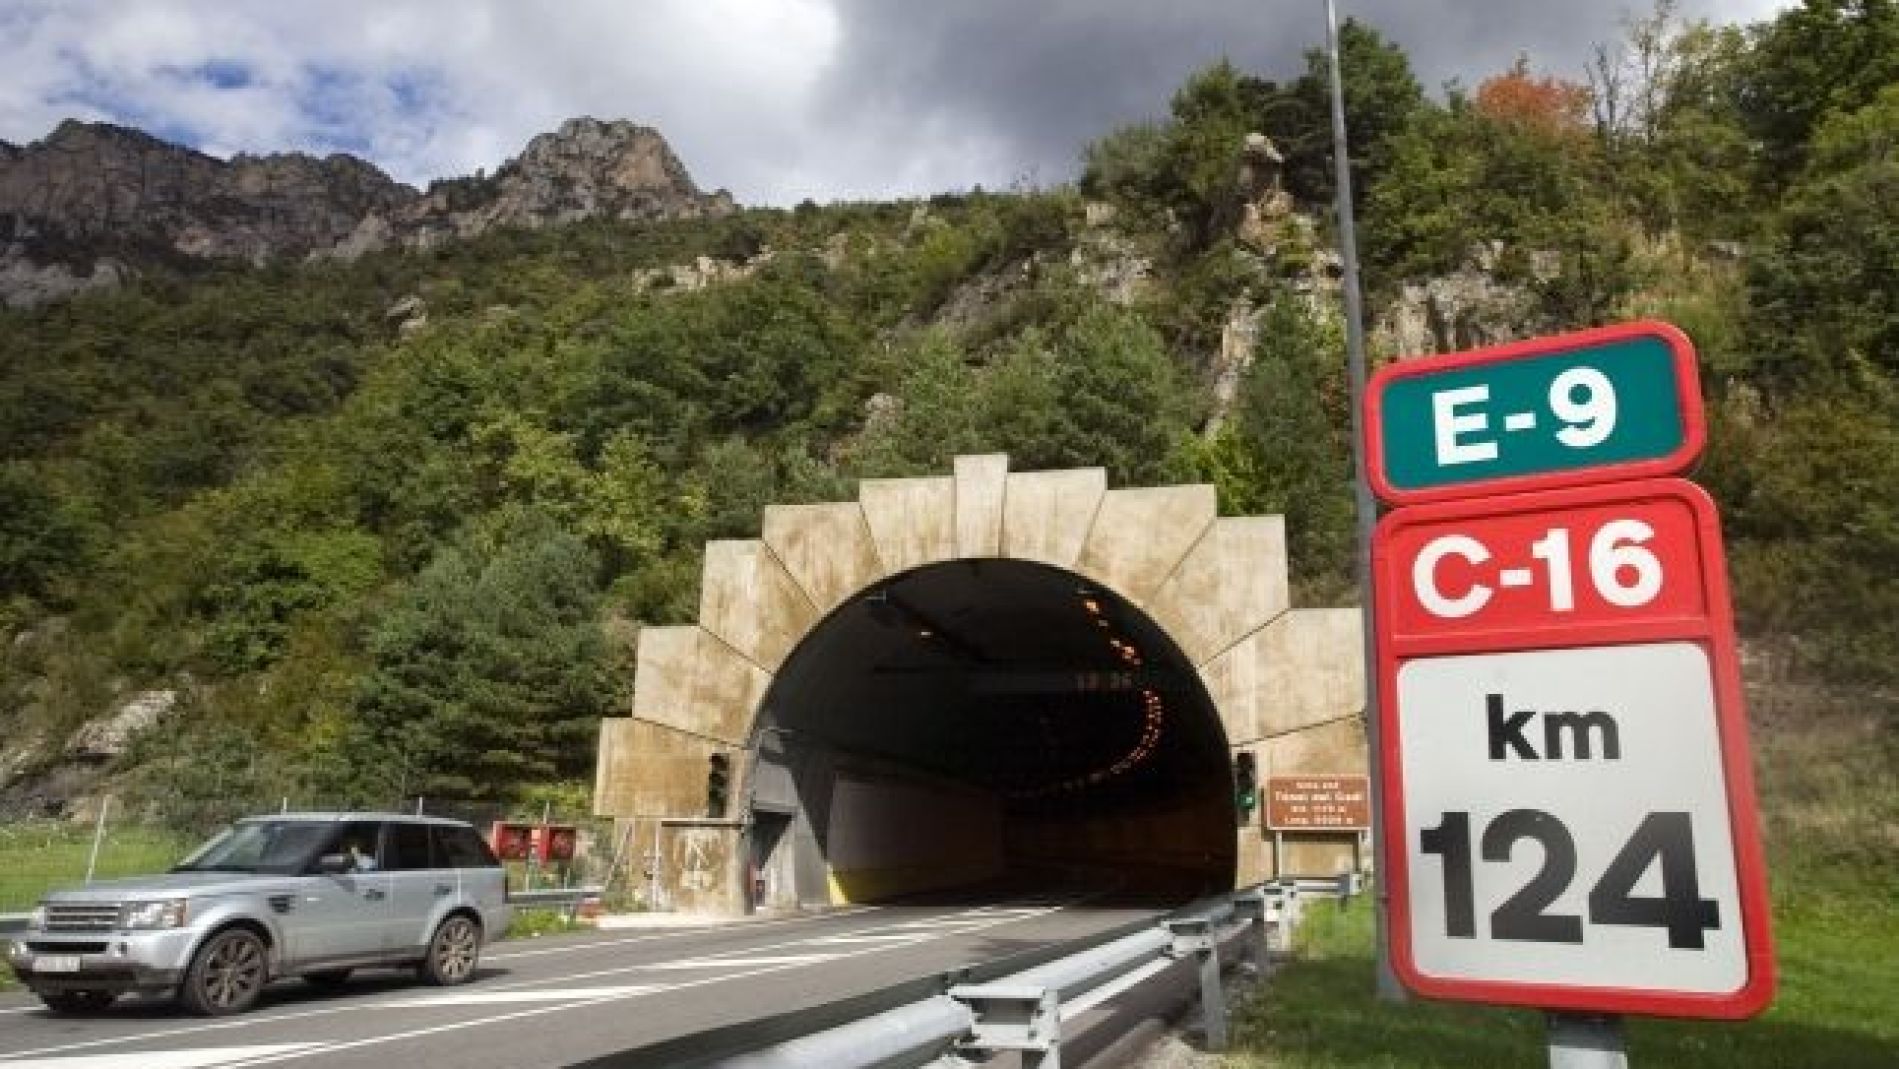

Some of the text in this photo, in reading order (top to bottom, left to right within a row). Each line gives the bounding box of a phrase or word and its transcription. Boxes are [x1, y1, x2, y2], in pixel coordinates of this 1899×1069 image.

[1433, 369, 1615, 464] E-9
[1414, 520, 1662, 617] C-16
[1486, 694, 1619, 759] km
[1420, 809, 1721, 951] 124
